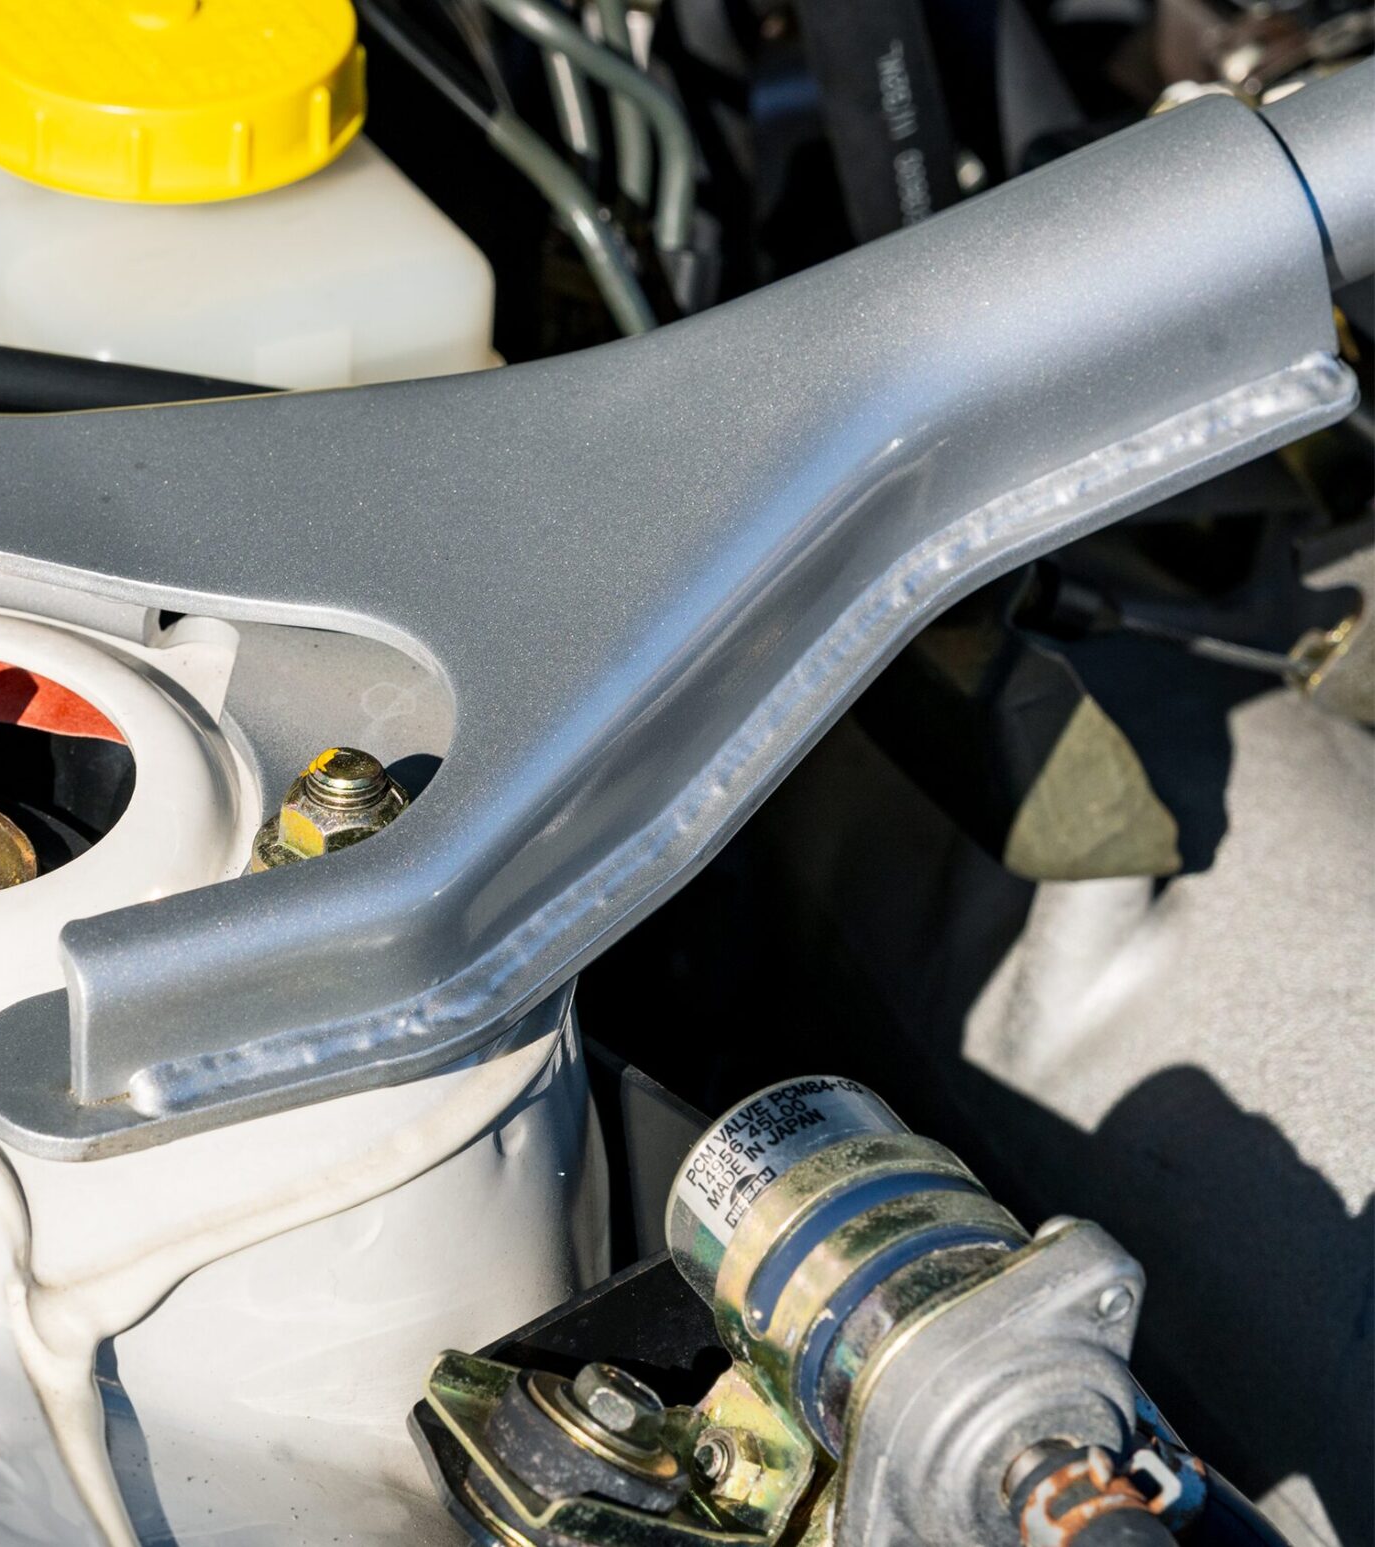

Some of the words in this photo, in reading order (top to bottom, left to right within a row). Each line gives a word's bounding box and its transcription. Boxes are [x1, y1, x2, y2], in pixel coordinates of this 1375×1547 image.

[686, 1144, 717, 1186] PCM
[713, 1101, 769, 1145] VALVE
[697, 1139, 744, 1194] 14956
[748, 1099, 808, 1137] 45L00
[707, 1165, 747, 1210] MADE
[746, 1142, 766, 1162] IN
[767, 1108, 826, 1146] JAPAN
